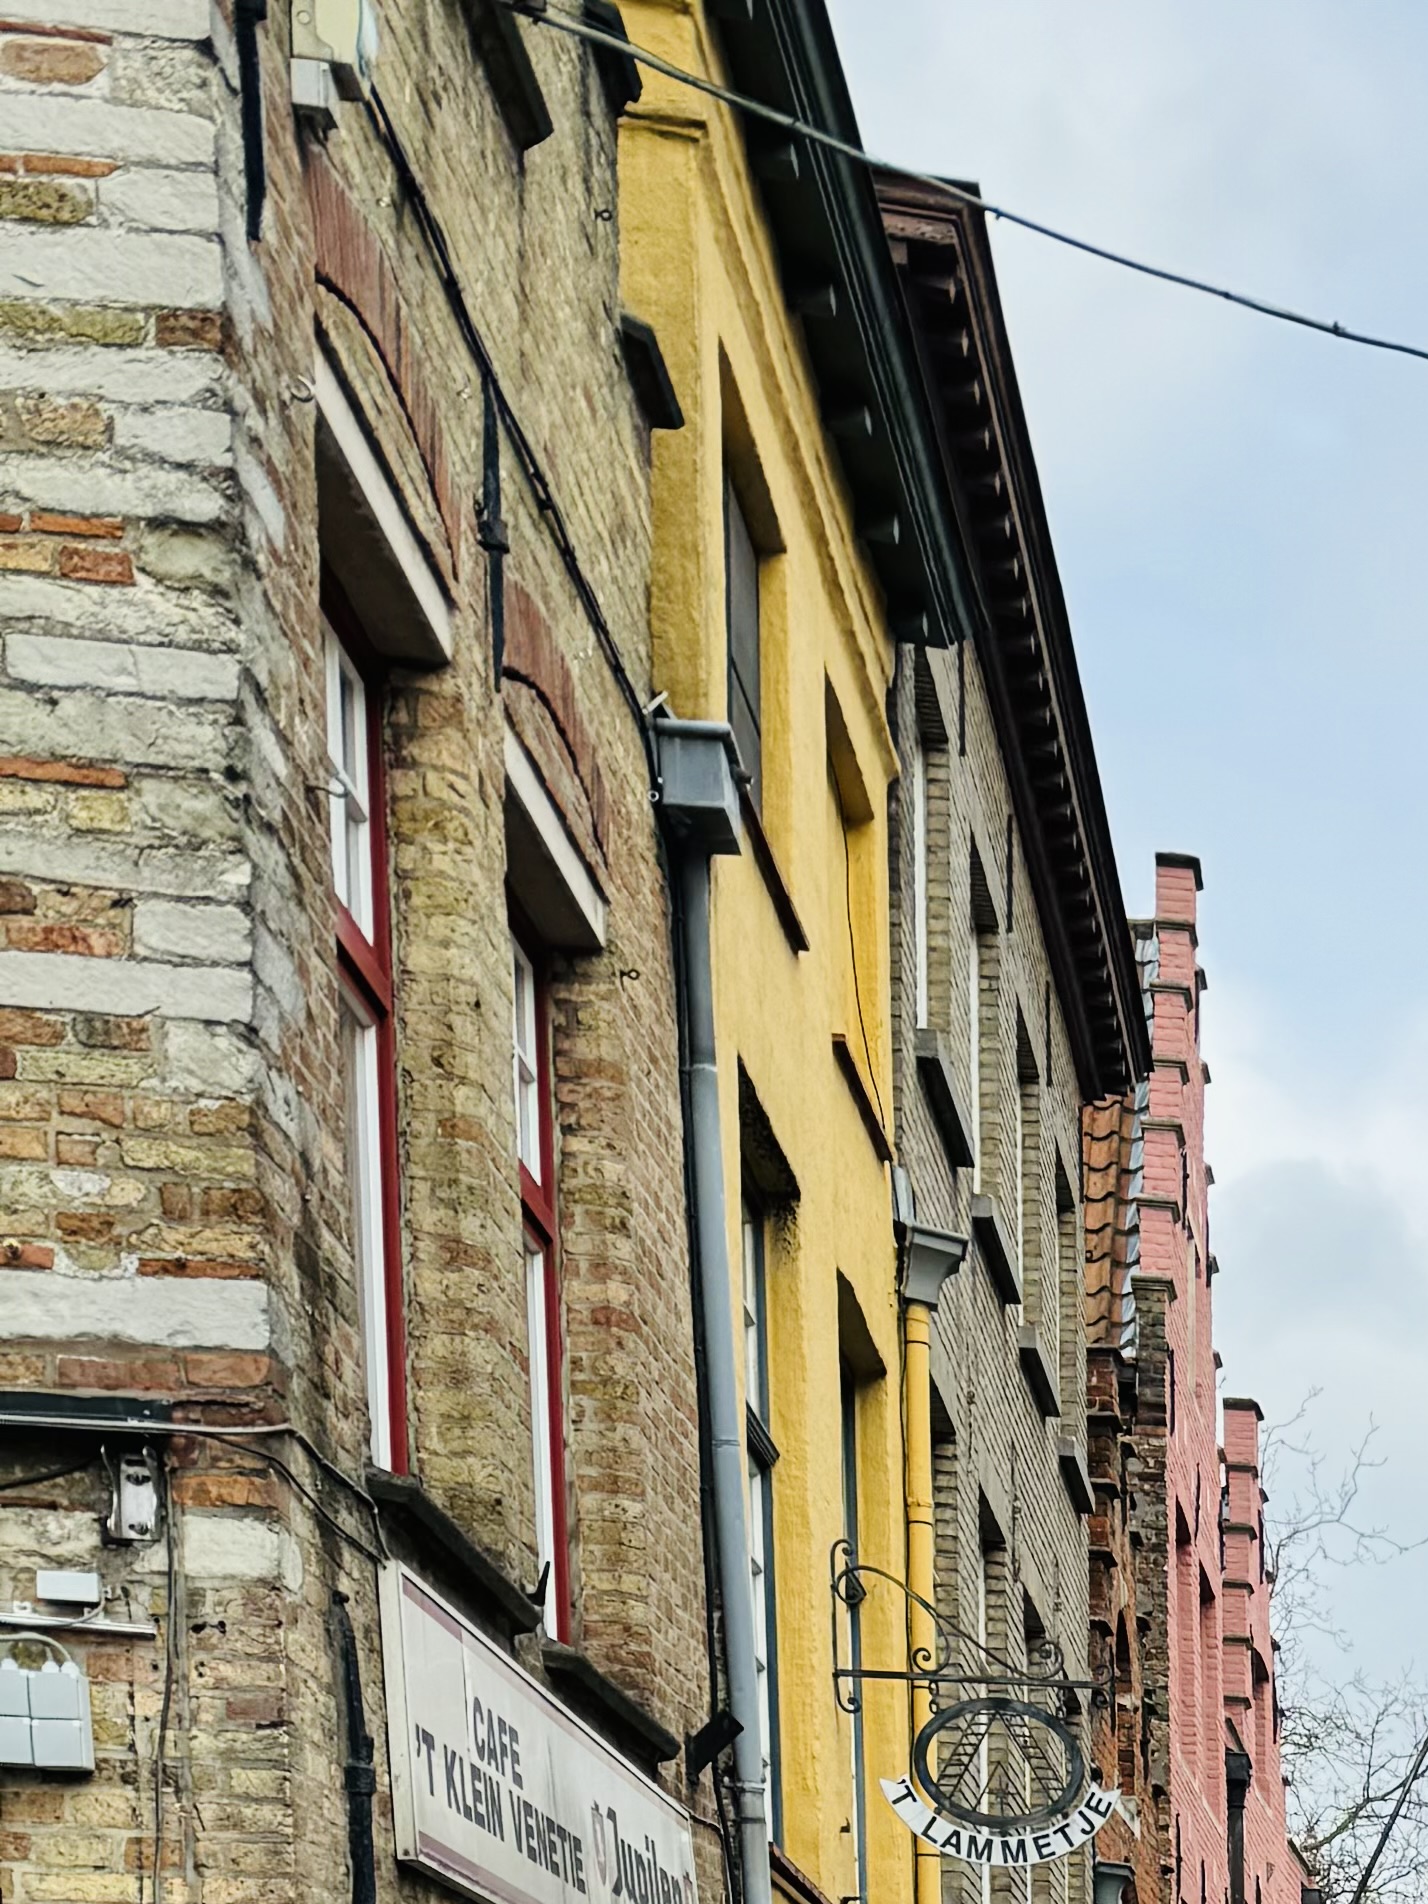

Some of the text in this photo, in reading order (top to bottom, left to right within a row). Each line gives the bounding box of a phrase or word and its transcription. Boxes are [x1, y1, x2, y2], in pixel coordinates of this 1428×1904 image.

[472, 1694, 525, 1791] CAFE
[443, 1742, 506, 1844] KLEIN
[508, 1789, 587, 1896] VENETIE
[920, 1790, 1113, 1865] LAMMETJE
